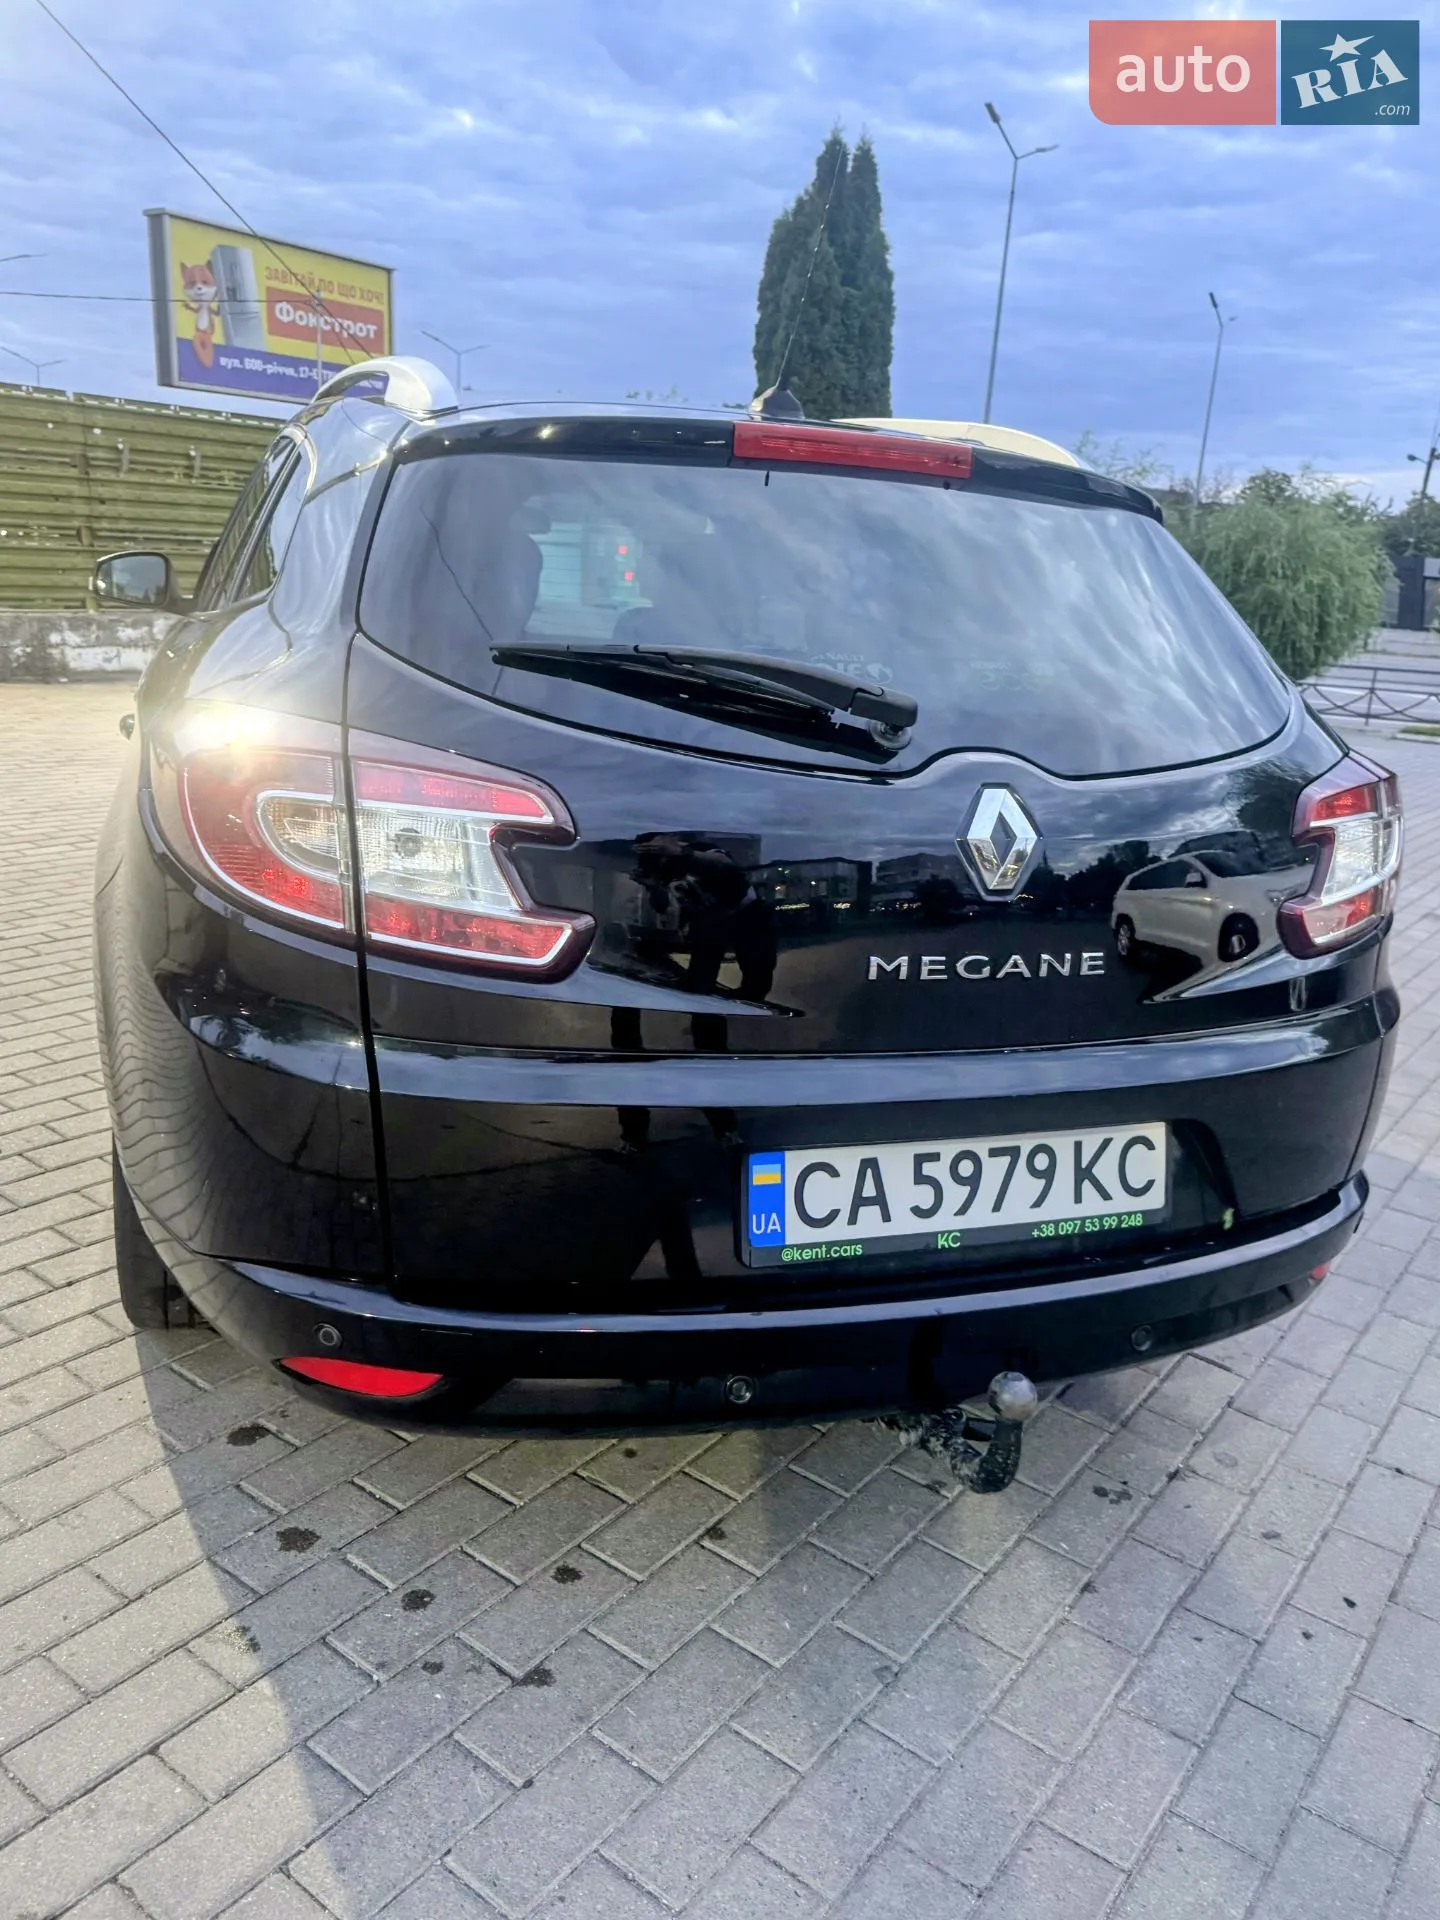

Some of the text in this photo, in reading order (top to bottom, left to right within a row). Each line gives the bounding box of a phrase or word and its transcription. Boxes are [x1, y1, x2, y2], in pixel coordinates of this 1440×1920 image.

[275, 301, 377, 339] Фокстрот
[868, 952, 1105, 980] MEGANE
[793, 1135, 1156, 1229] CA 5979 KC
[752, 1213, 782, 1235] UA
[781, 1213, 1143, 1262] @kent.cars KC +38 097 53 99 248
